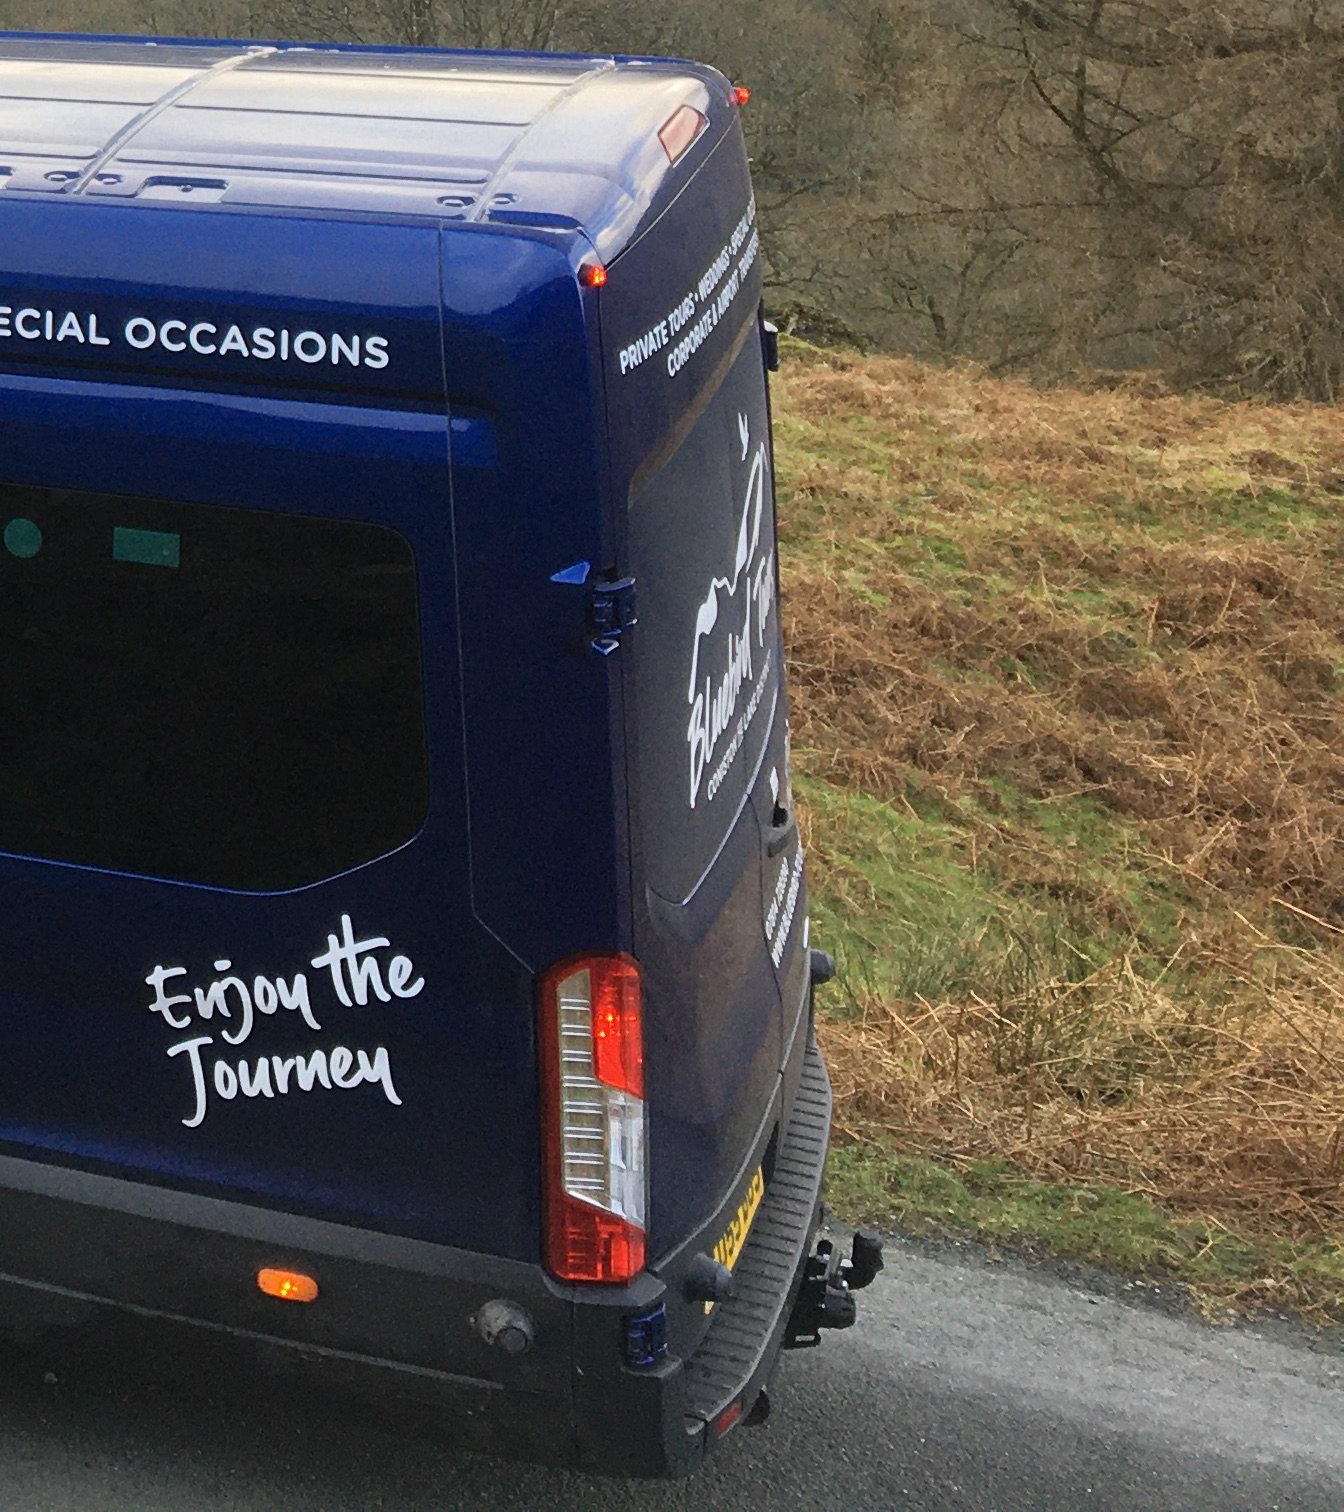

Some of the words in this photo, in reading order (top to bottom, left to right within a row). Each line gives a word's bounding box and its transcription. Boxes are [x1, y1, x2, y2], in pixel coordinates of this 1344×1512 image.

[124, 317, 389, 369] OCCASIONS
[619, 319, 669, 375] PRIVATE
[144, 959, 322, 1045] Enjoy
[310, 913, 425, 1008] the
[166, 1036, 403, 1128] Journey
